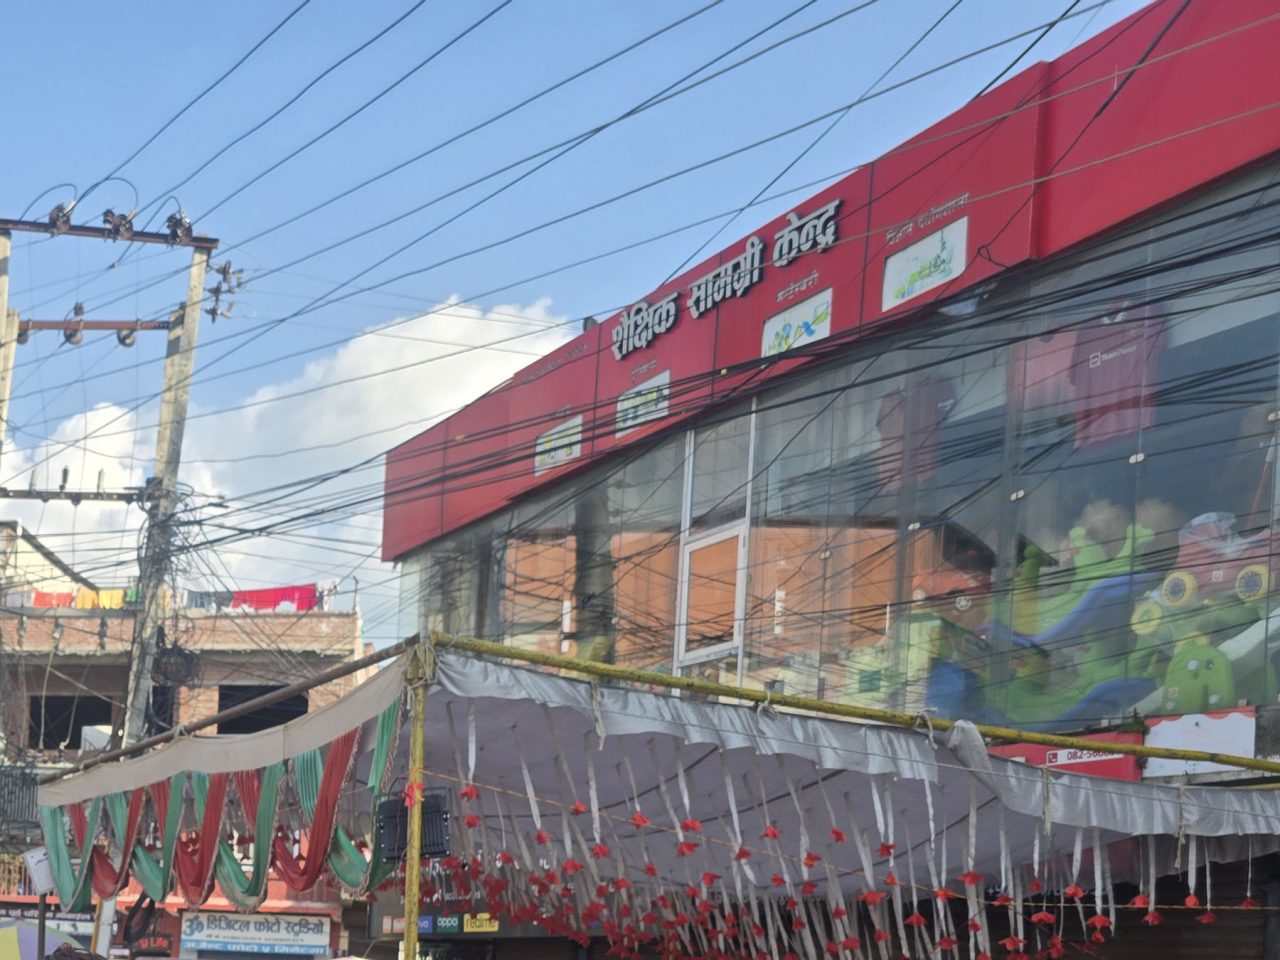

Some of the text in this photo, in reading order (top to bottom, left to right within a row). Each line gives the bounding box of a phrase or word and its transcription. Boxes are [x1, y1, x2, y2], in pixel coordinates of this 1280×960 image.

[610, 198, 842, 361] शैक्षिक सामग्री केन्द्र
[207, 914, 251, 933] डिजिटल
[254, 917, 281, 934] फोटो
[437, 917, 459, 928] oppo
